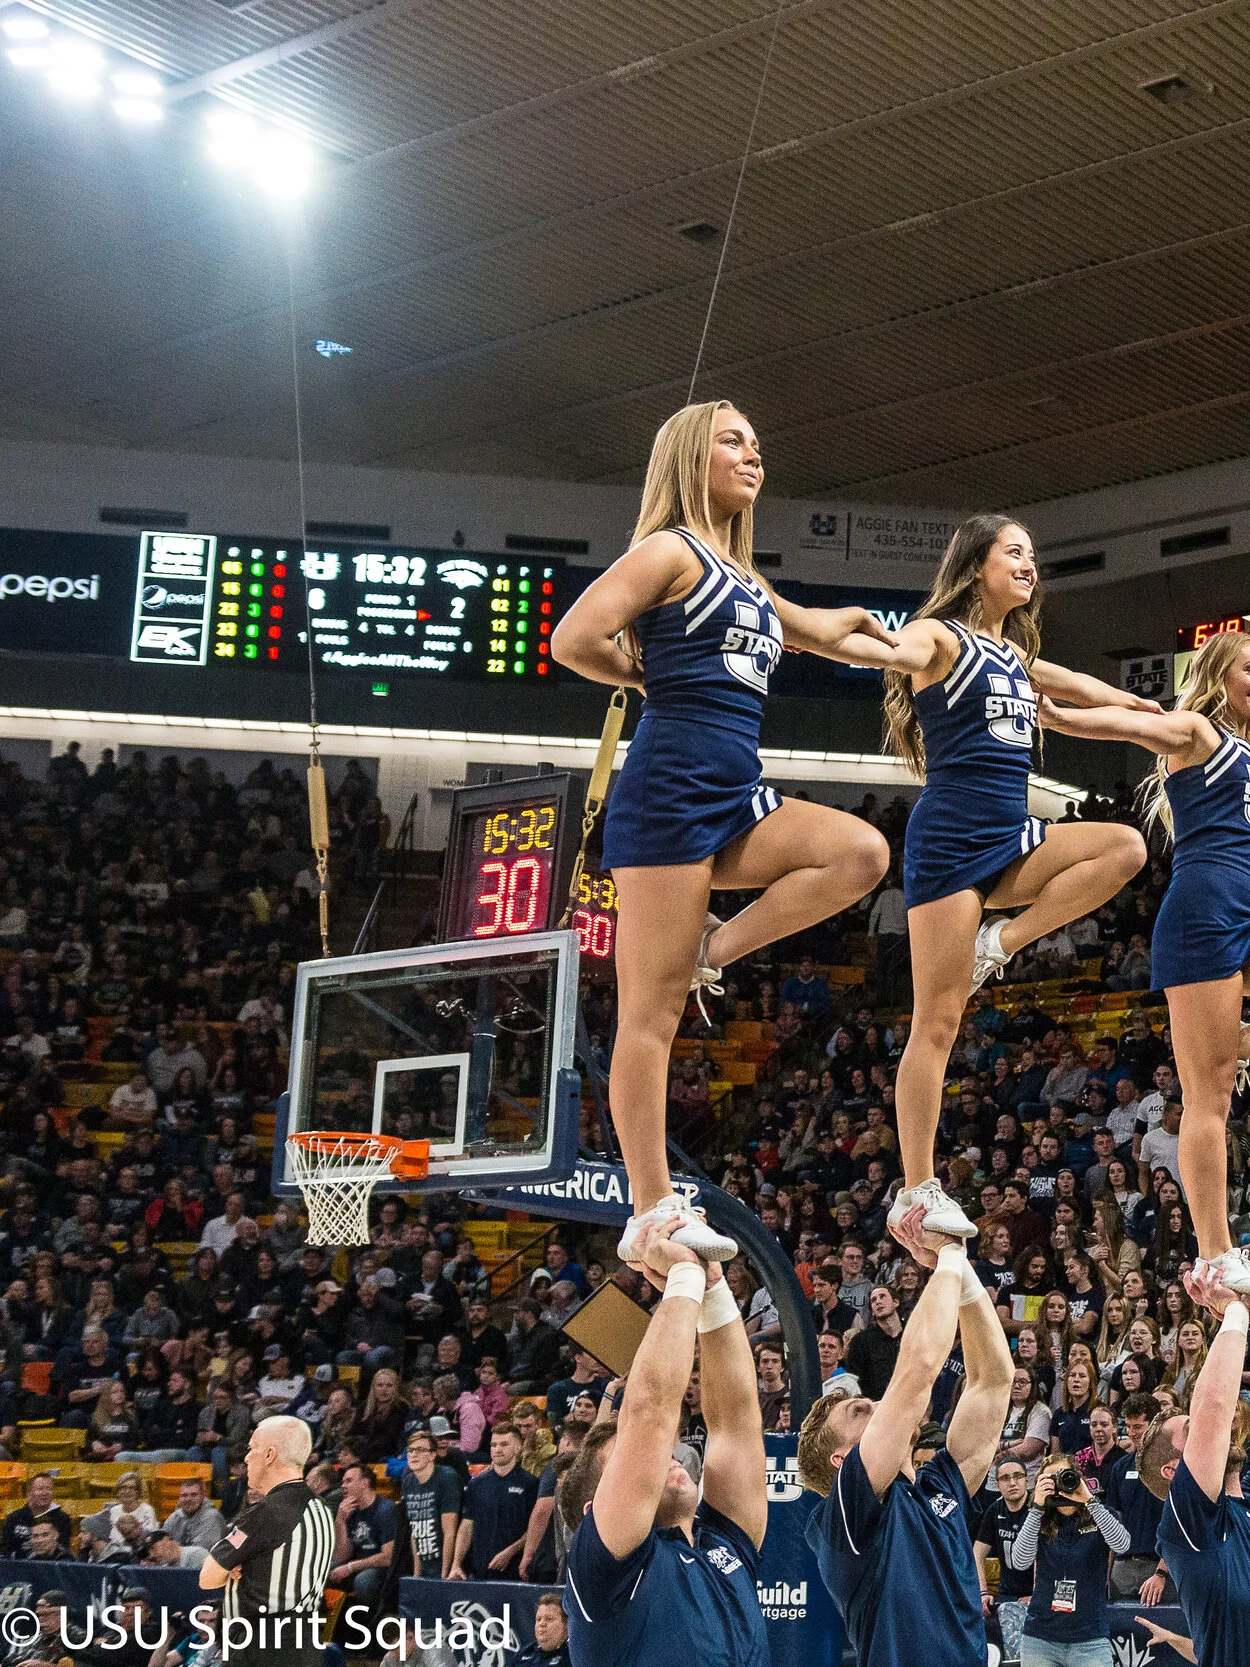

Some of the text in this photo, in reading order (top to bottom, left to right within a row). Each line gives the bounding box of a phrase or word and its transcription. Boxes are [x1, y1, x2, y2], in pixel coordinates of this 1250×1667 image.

[855, 516, 891, 533] AGGIE
[895, 519, 917, 534] FAN
[922, 521, 948, 533] TEXT
[352, 553, 427, 586] 15:32
[0, 573, 100, 603] pepsi
[308, 587, 326, 610] 6
[542, 581, 553, 595] 0
[450, 596, 466, 619] 2
[517, 600, 529, 614] 2
[540, 601, 552, 615] 0
[539, 621, 551, 635] 0
[538, 641, 549, 655] 0
[536, 661, 548, 675] 0
[1125, 669, 1169, 688] STATE
[483, 806, 555, 855] 15:32
[473, 855, 541, 938] 30
[573, 909, 613, 958] 30
